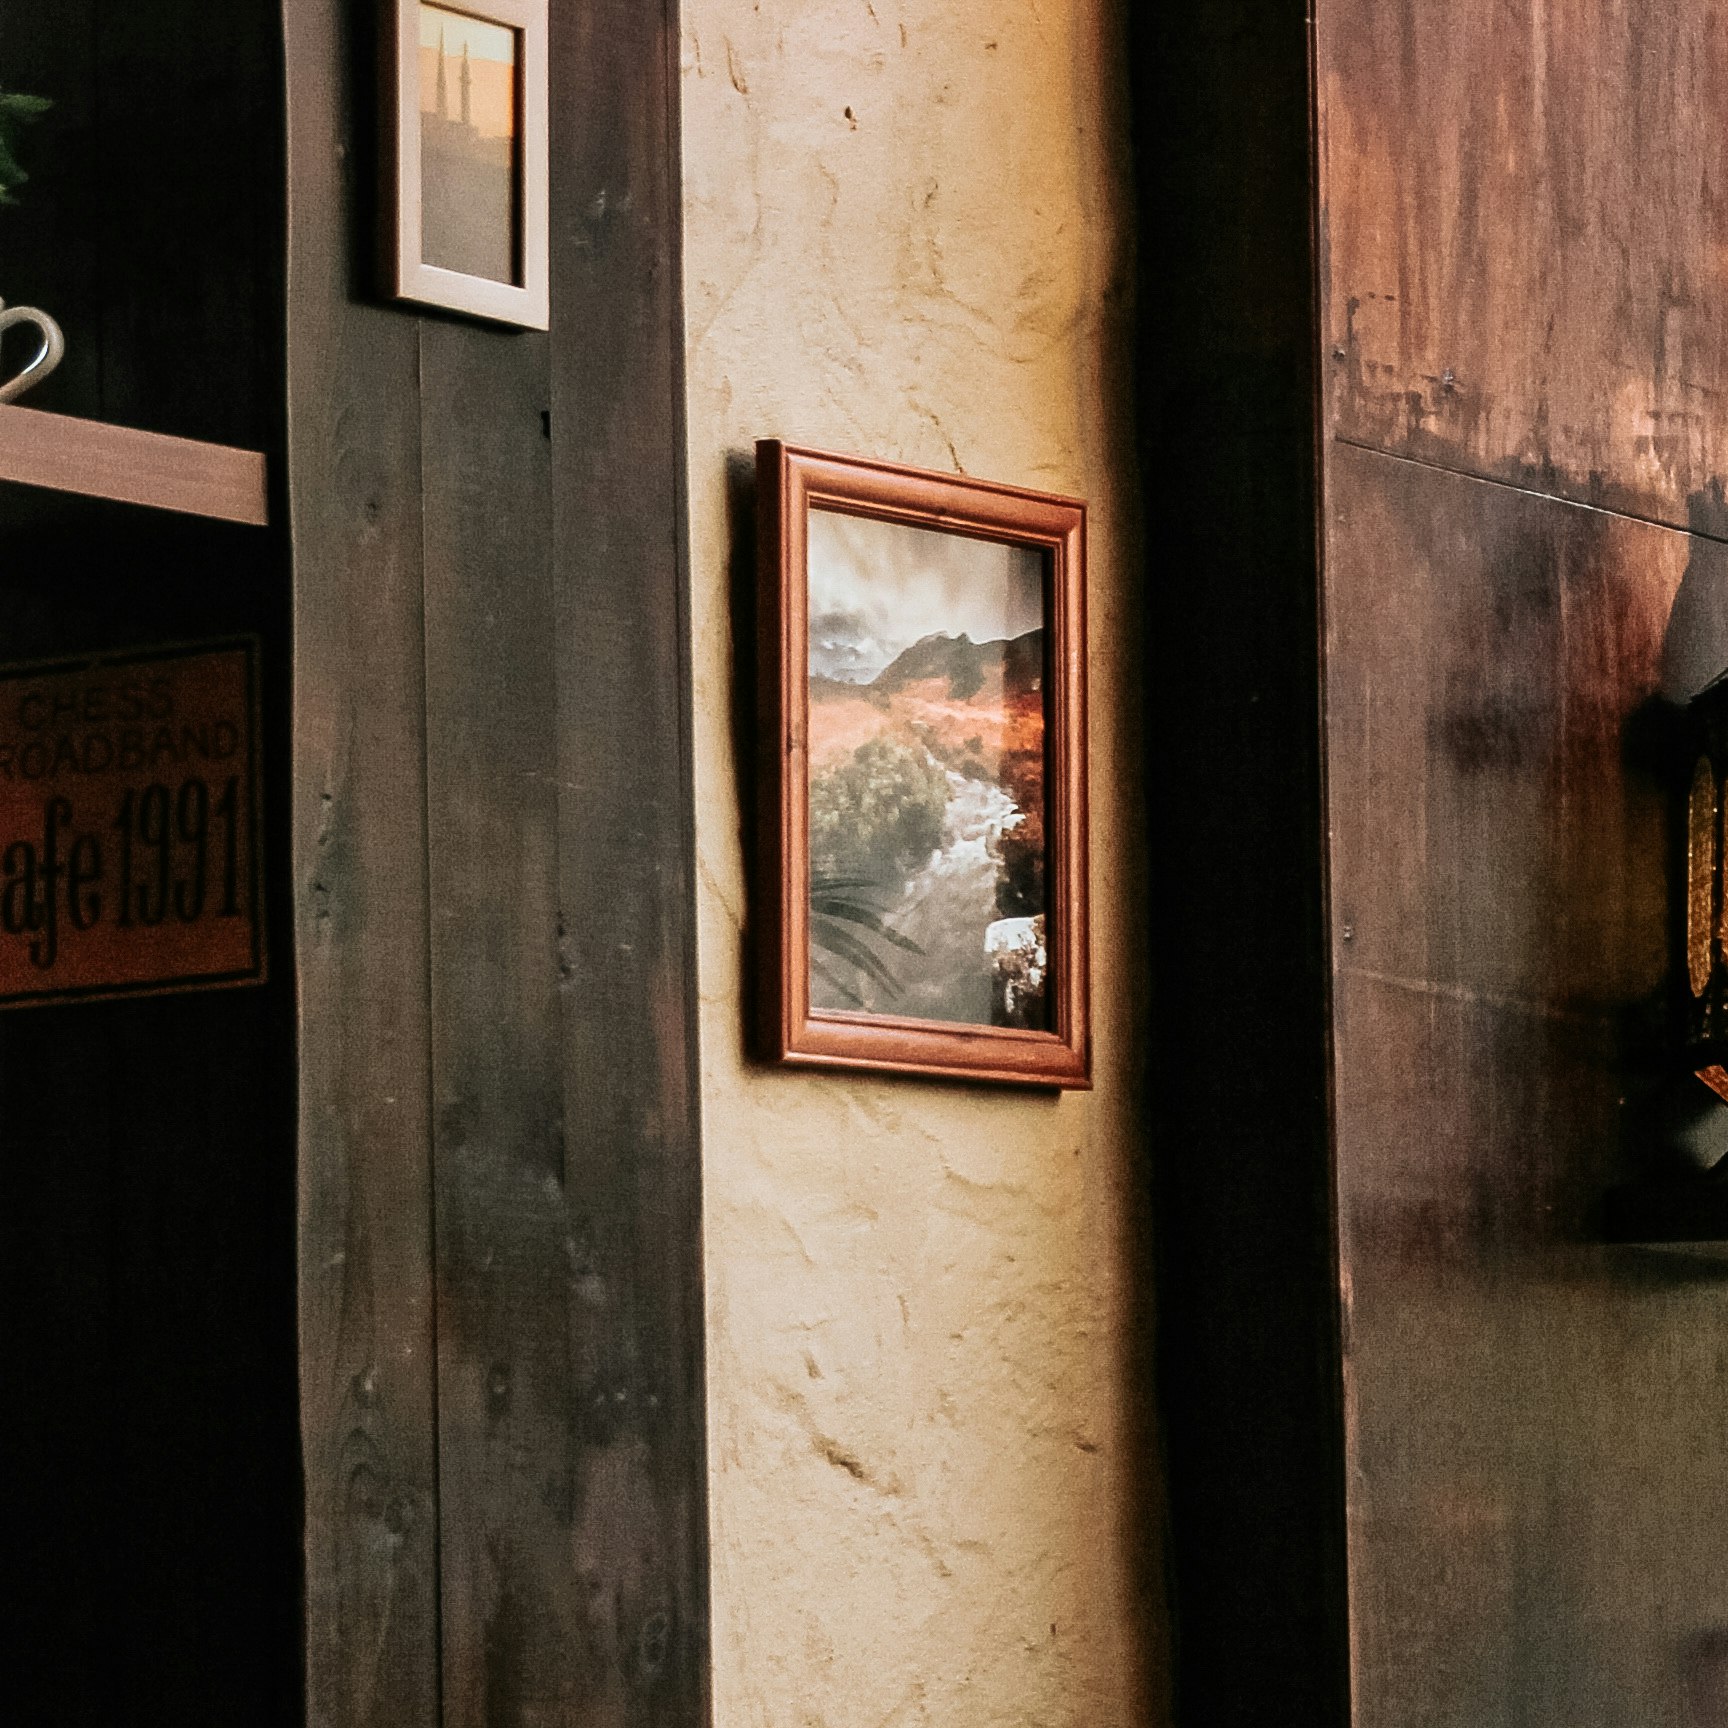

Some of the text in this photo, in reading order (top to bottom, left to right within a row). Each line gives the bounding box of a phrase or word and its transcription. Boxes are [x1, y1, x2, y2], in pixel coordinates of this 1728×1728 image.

[19, 677, 174, 731] CHESS
[0, 719, 239, 780] ROADBAND
[2, 775, 240, 970] afe 1991
